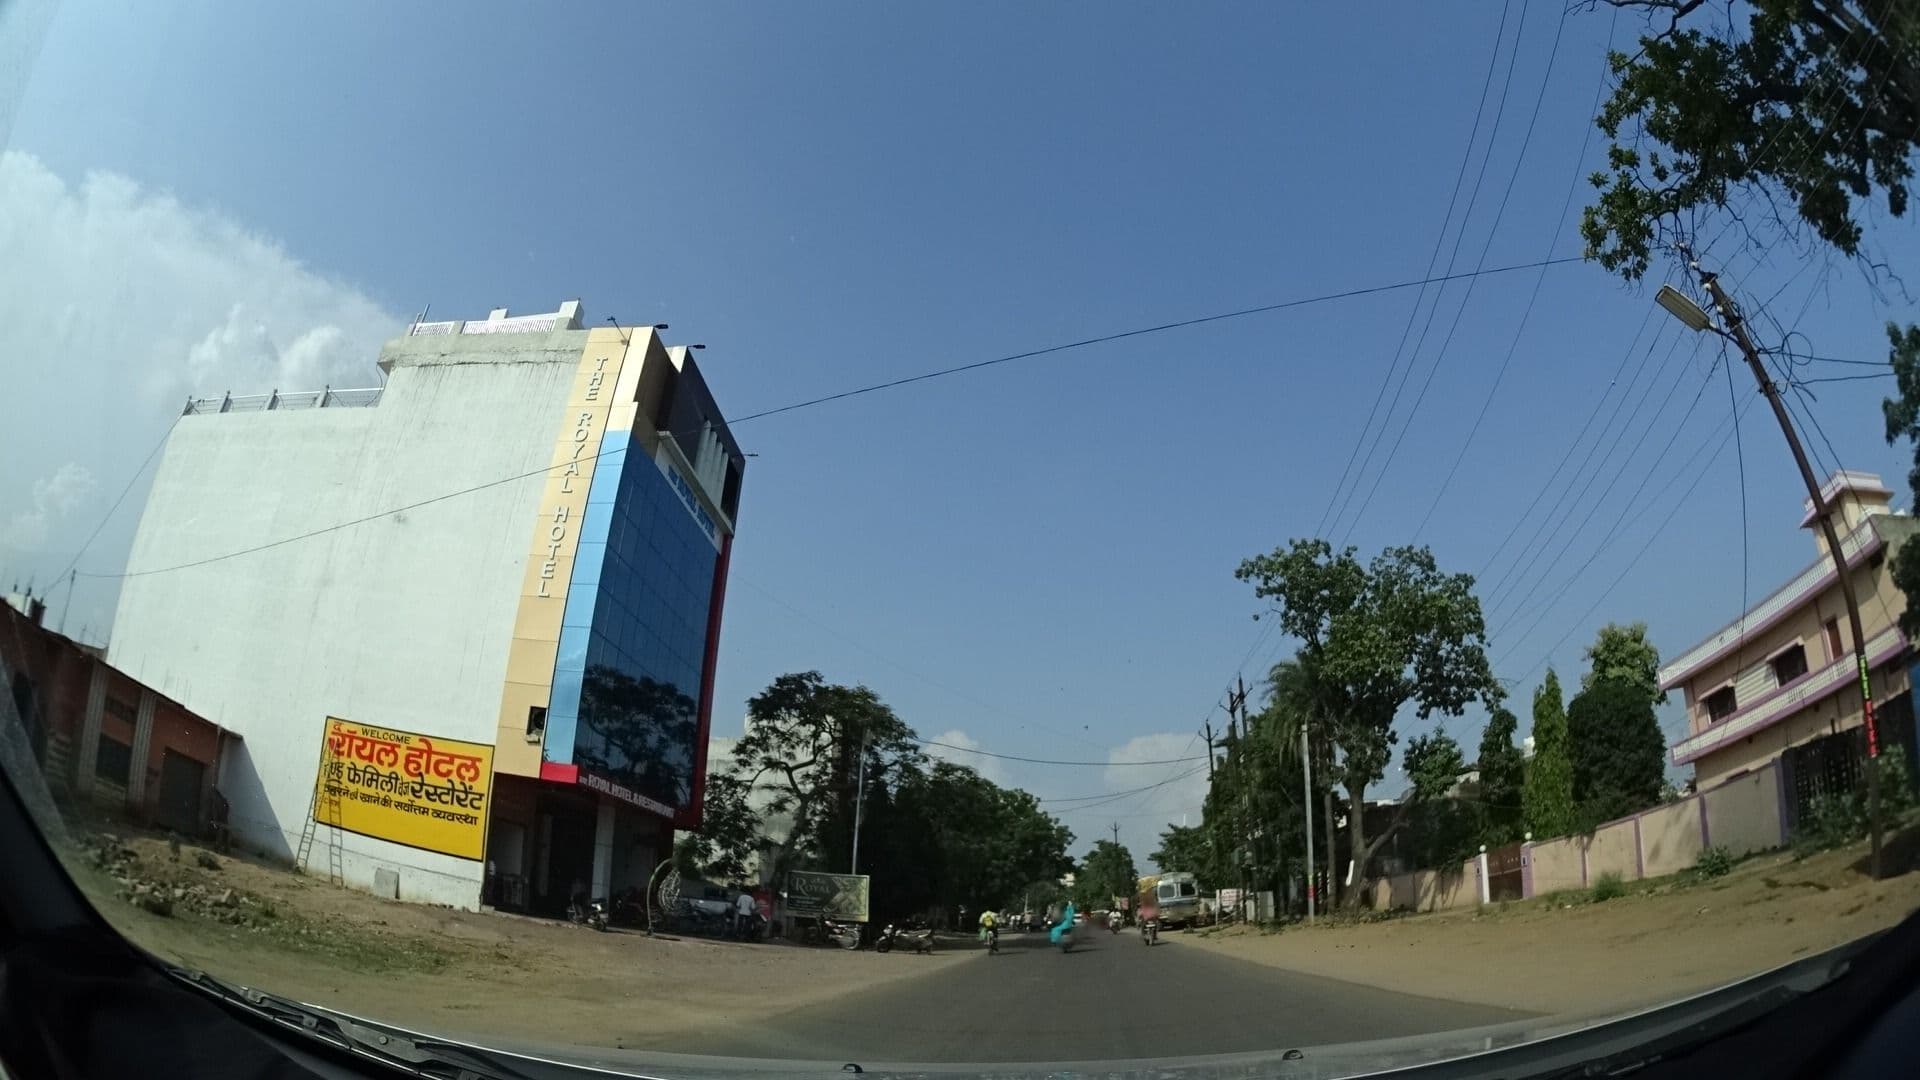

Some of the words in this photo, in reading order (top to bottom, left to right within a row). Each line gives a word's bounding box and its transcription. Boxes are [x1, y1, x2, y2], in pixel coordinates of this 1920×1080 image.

[585, 356, 609, 402] THE
[561, 412, 593, 494] ROYAL
[538, 506, 570, 599] HOTEL
[329, 729, 401, 768] रॉयल
[403, 737, 483, 783] होटल
[361, 727, 412, 745] WELCOME
[347, 761, 400, 794] फेमिली
[410, 772, 485, 811] रेस्टोरेंट
